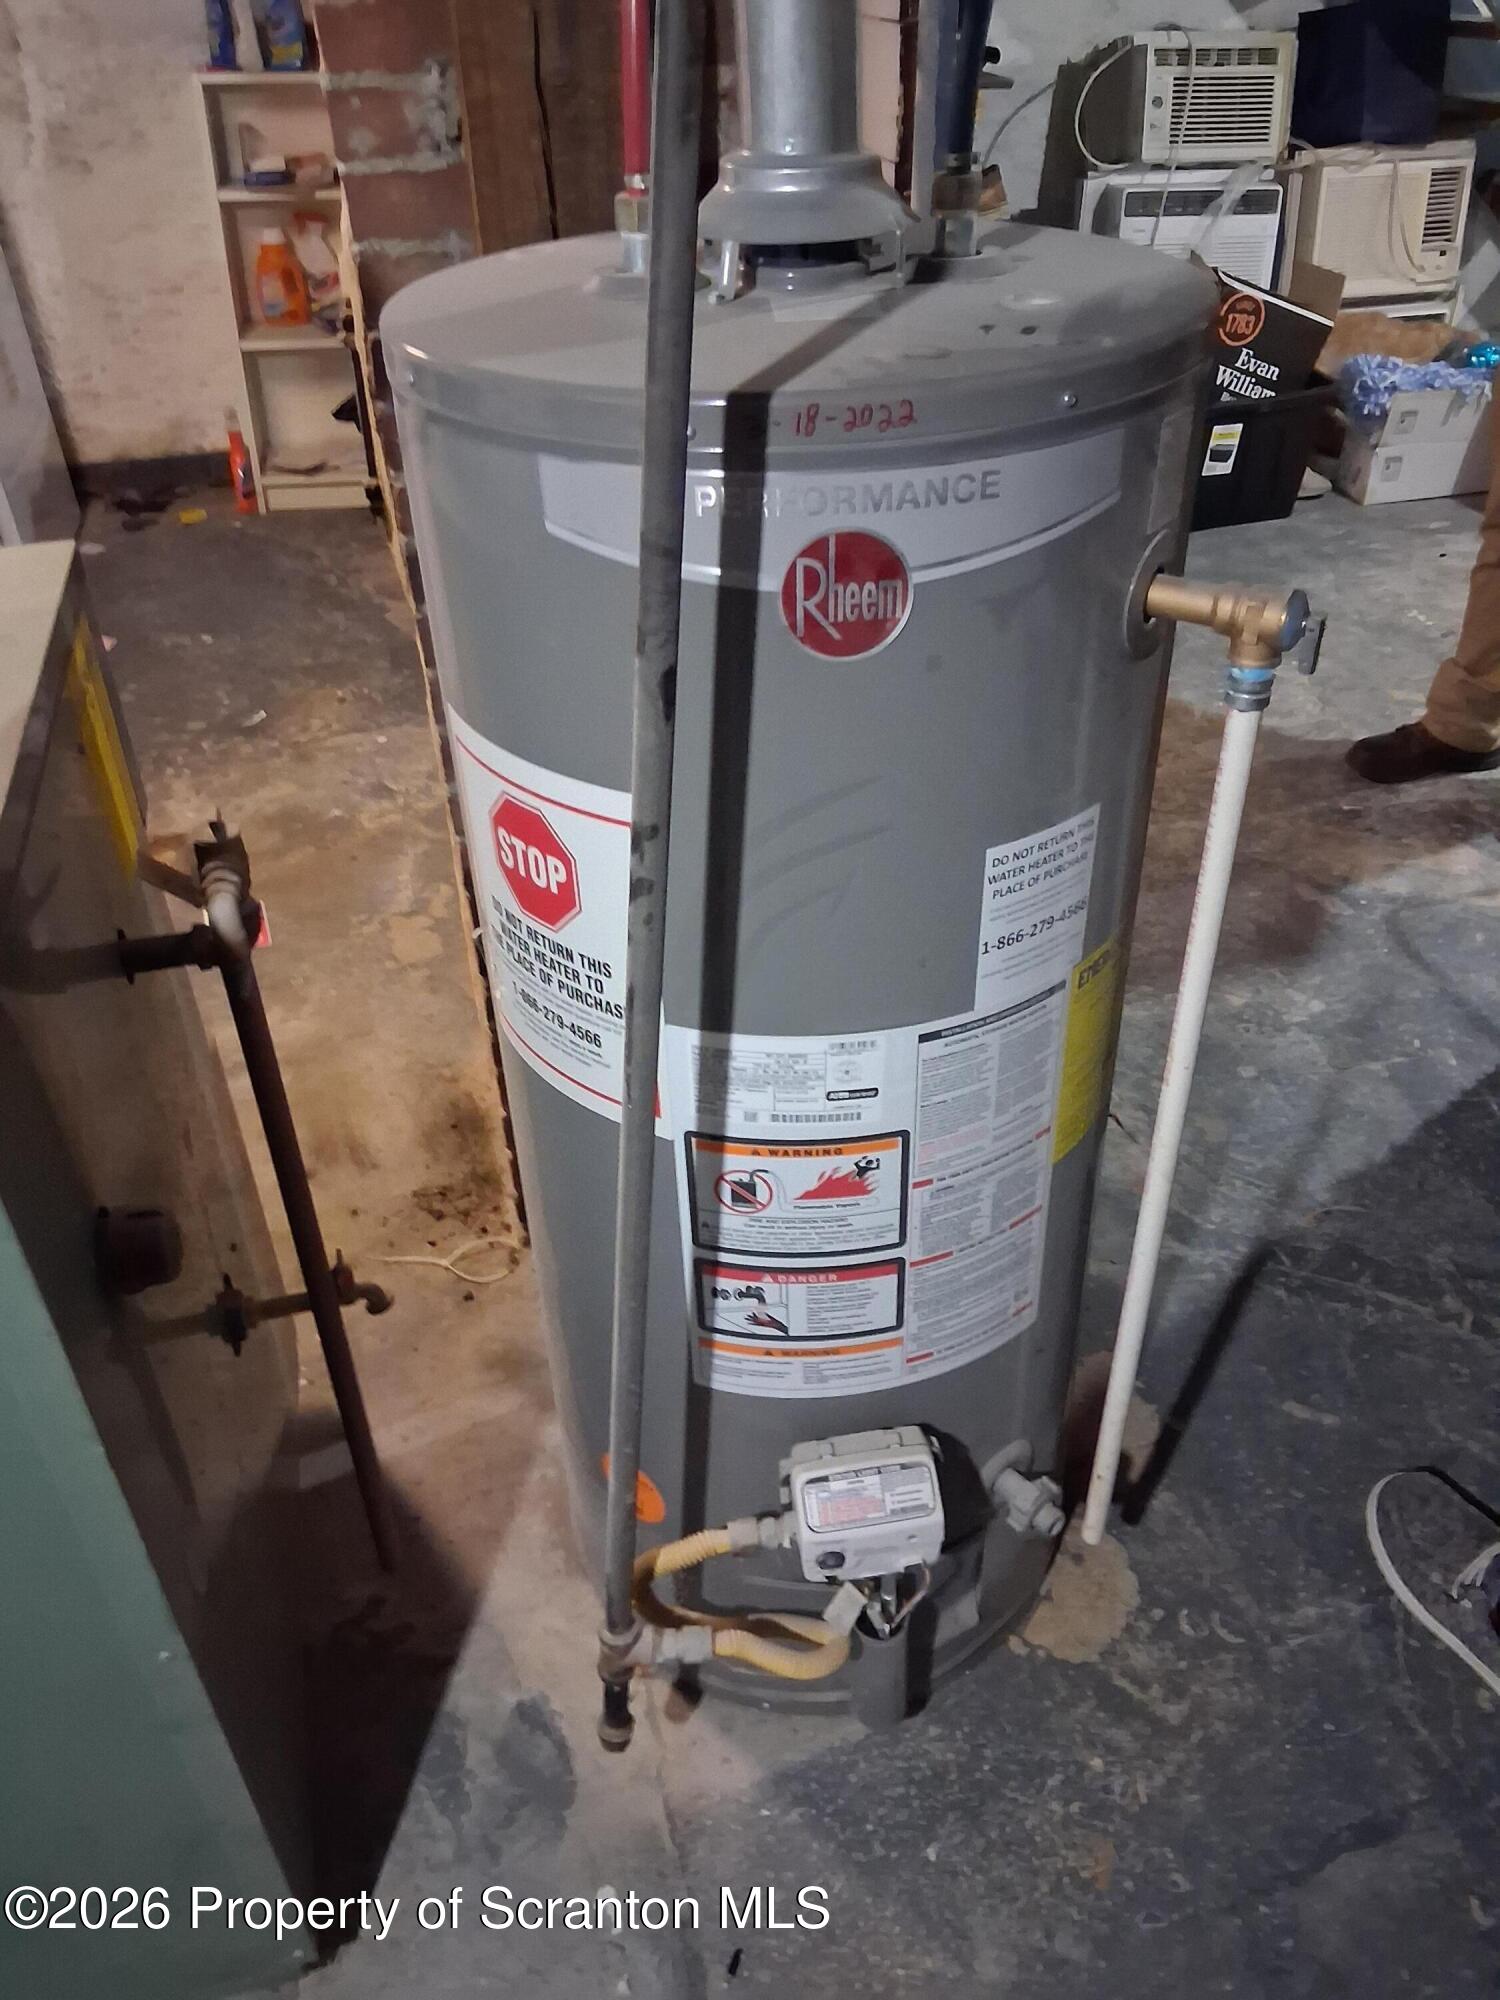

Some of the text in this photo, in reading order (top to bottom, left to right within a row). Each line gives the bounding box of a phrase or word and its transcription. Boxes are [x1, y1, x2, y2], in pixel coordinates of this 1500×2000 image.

[1226, 313, 1256, 335] 1783
[1235, 347, 1280, 381] Evan
[695, 470, 1001, 518] PFORMANCE
[796, 535, 902, 641] Rheem
[497, 825, 567, 895] STOP
[988, 865, 1025, 886] WATER
[1028, 849, 1064, 872] HEATER
[1066, 841, 1079, 855] TO
[991, 855, 1009, 869] DO
[1012, 845, 1035, 862] NOT
[1037, 829, 1075, 853] RETURN
[992, 881, 1025, 900] PLACE
[1027, 874, 1041, 888] OF
[500, 920, 605, 995] WATER HEATER TO
[506, 941, 537, 978] PLACE
[539, 967, 554, 988] OF
[526, 925, 575, 965] RETURN
[577, 951, 613, 979] THIS
[768, 1146, 844, 1158] WARNING
[776, 1272, 839, 1284] DANGER
